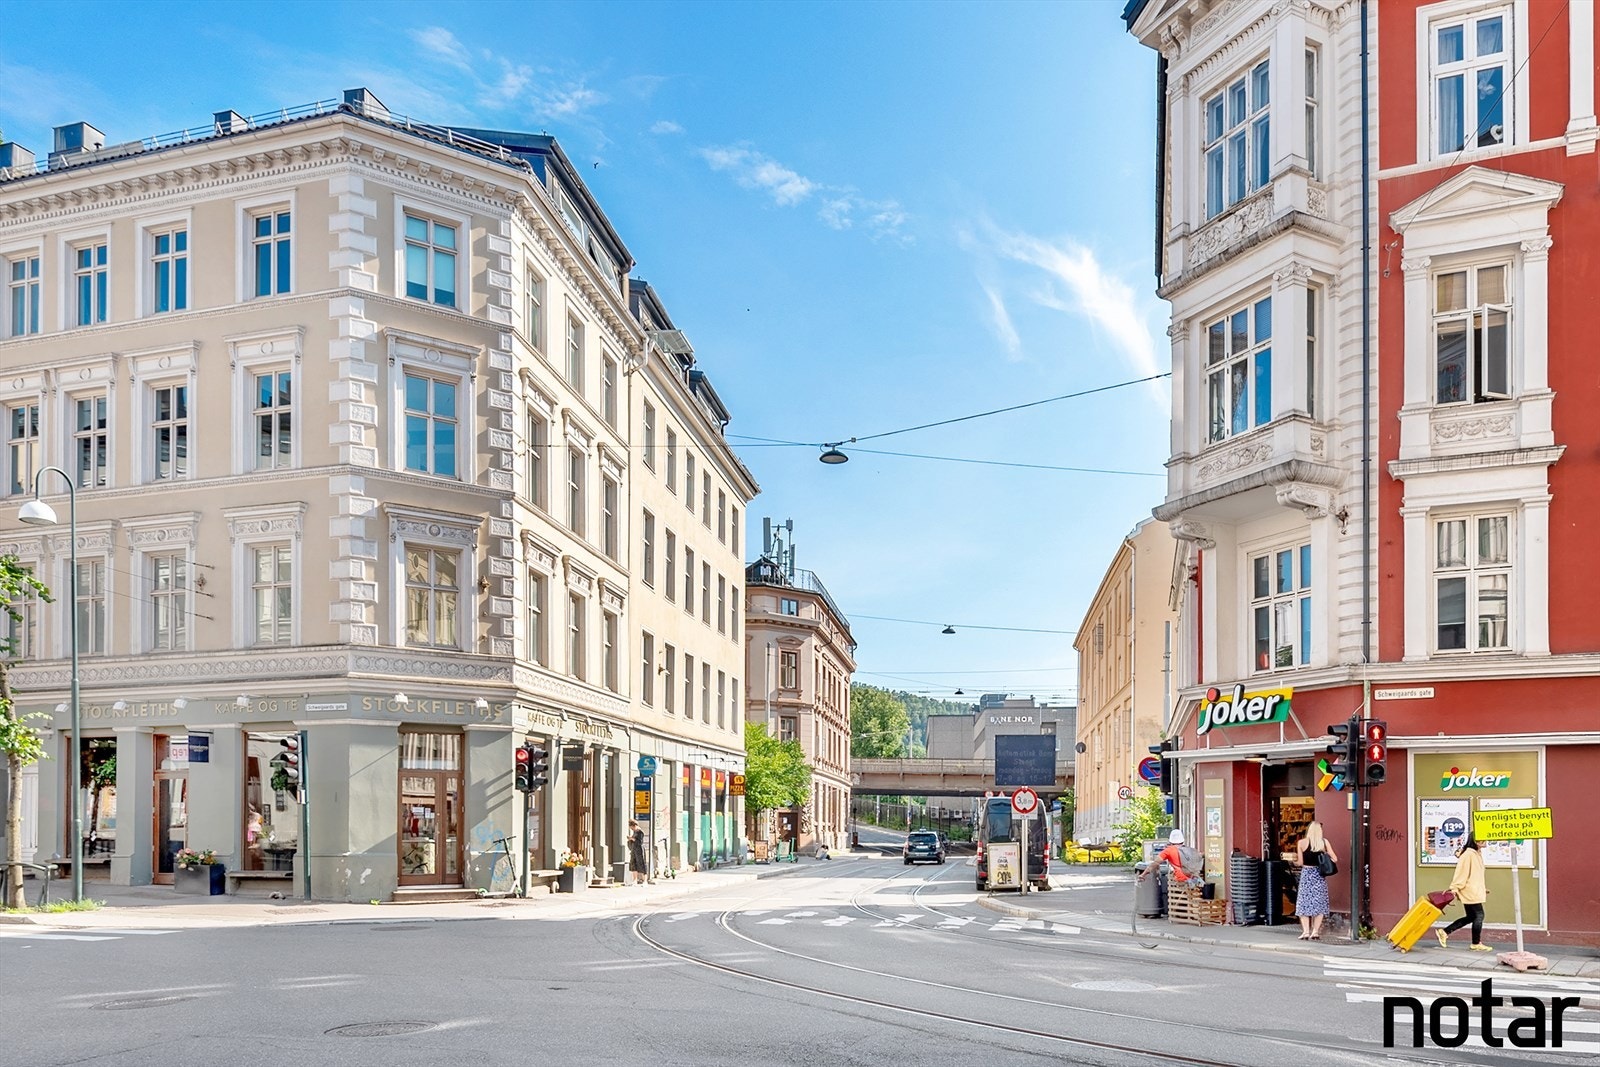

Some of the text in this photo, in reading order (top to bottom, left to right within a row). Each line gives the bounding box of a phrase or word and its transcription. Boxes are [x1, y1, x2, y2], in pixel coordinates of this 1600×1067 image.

[1377, 689, 1431, 698] Schweigaards gate
[215, 699, 299, 714] KAFFE OG TE
[361, 696, 504, 718] STOCKFLETHS
[1197, 684, 1283, 735] joker
[990, 716, 1035, 725] BANE NOR
[1442, 767, 1507, 791] joker
[1120, 789, 1130, 798] 40
[1475, 812, 1550, 822] Vennligst benytt
[1522, 820, 1534, 829] på
[1486, 829, 1540, 838] andre siden
